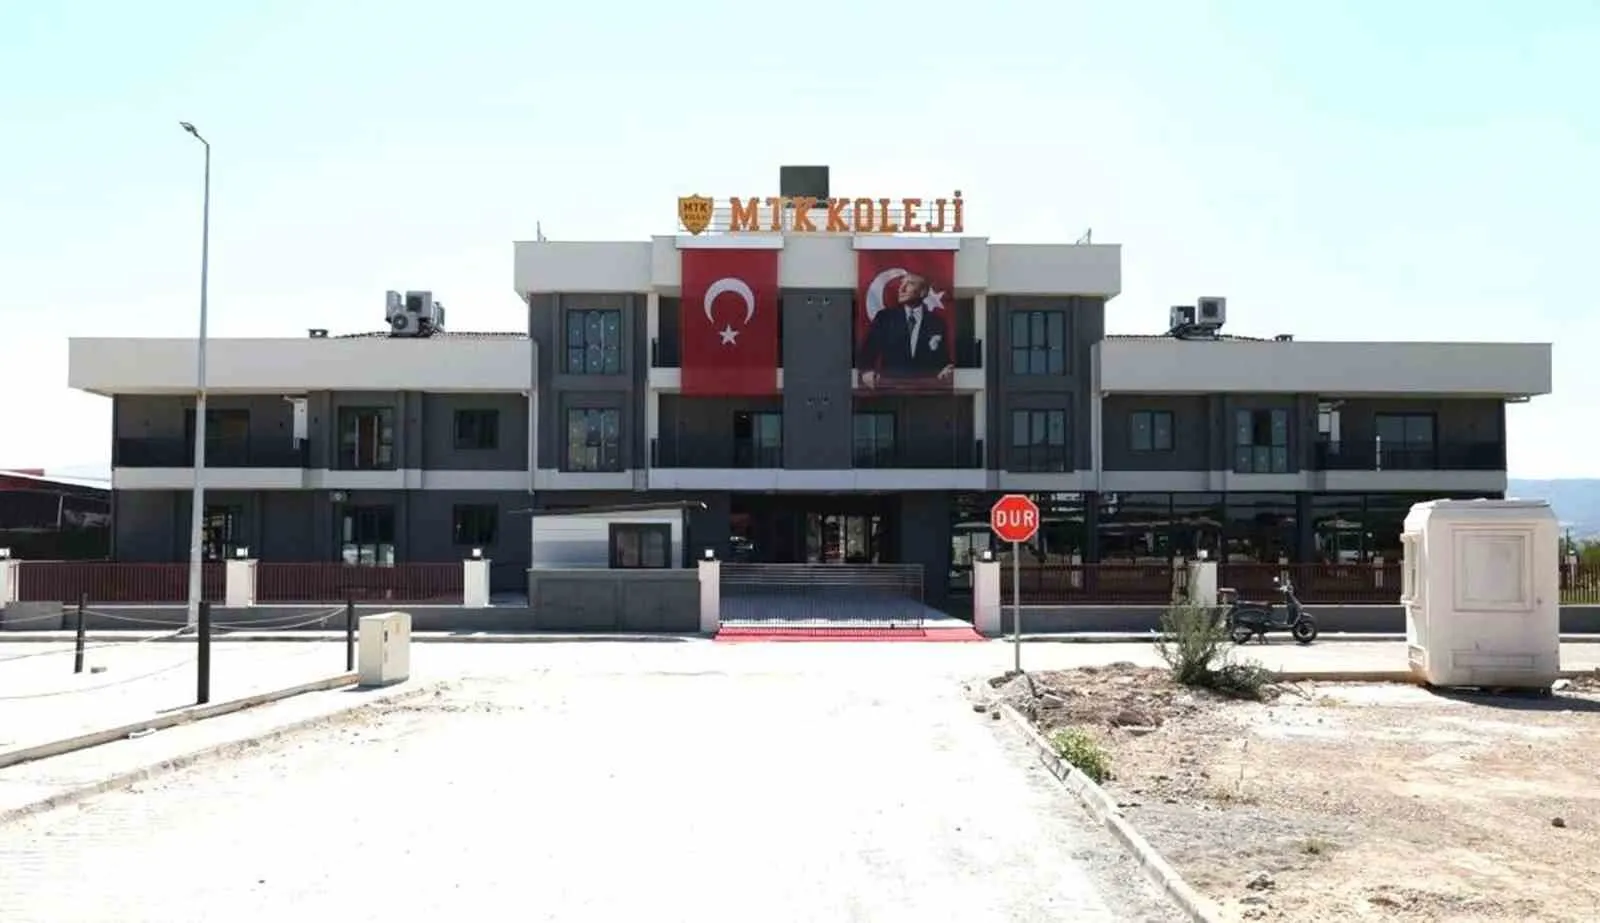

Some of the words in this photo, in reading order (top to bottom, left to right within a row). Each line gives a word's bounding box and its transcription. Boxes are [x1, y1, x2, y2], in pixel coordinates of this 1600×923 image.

[683, 202, 708, 212] MTK
[730, 197, 817, 232] MTK
[826, 190, 963, 232] KOLEJİ
[996, 509, 1034, 527] DUR
